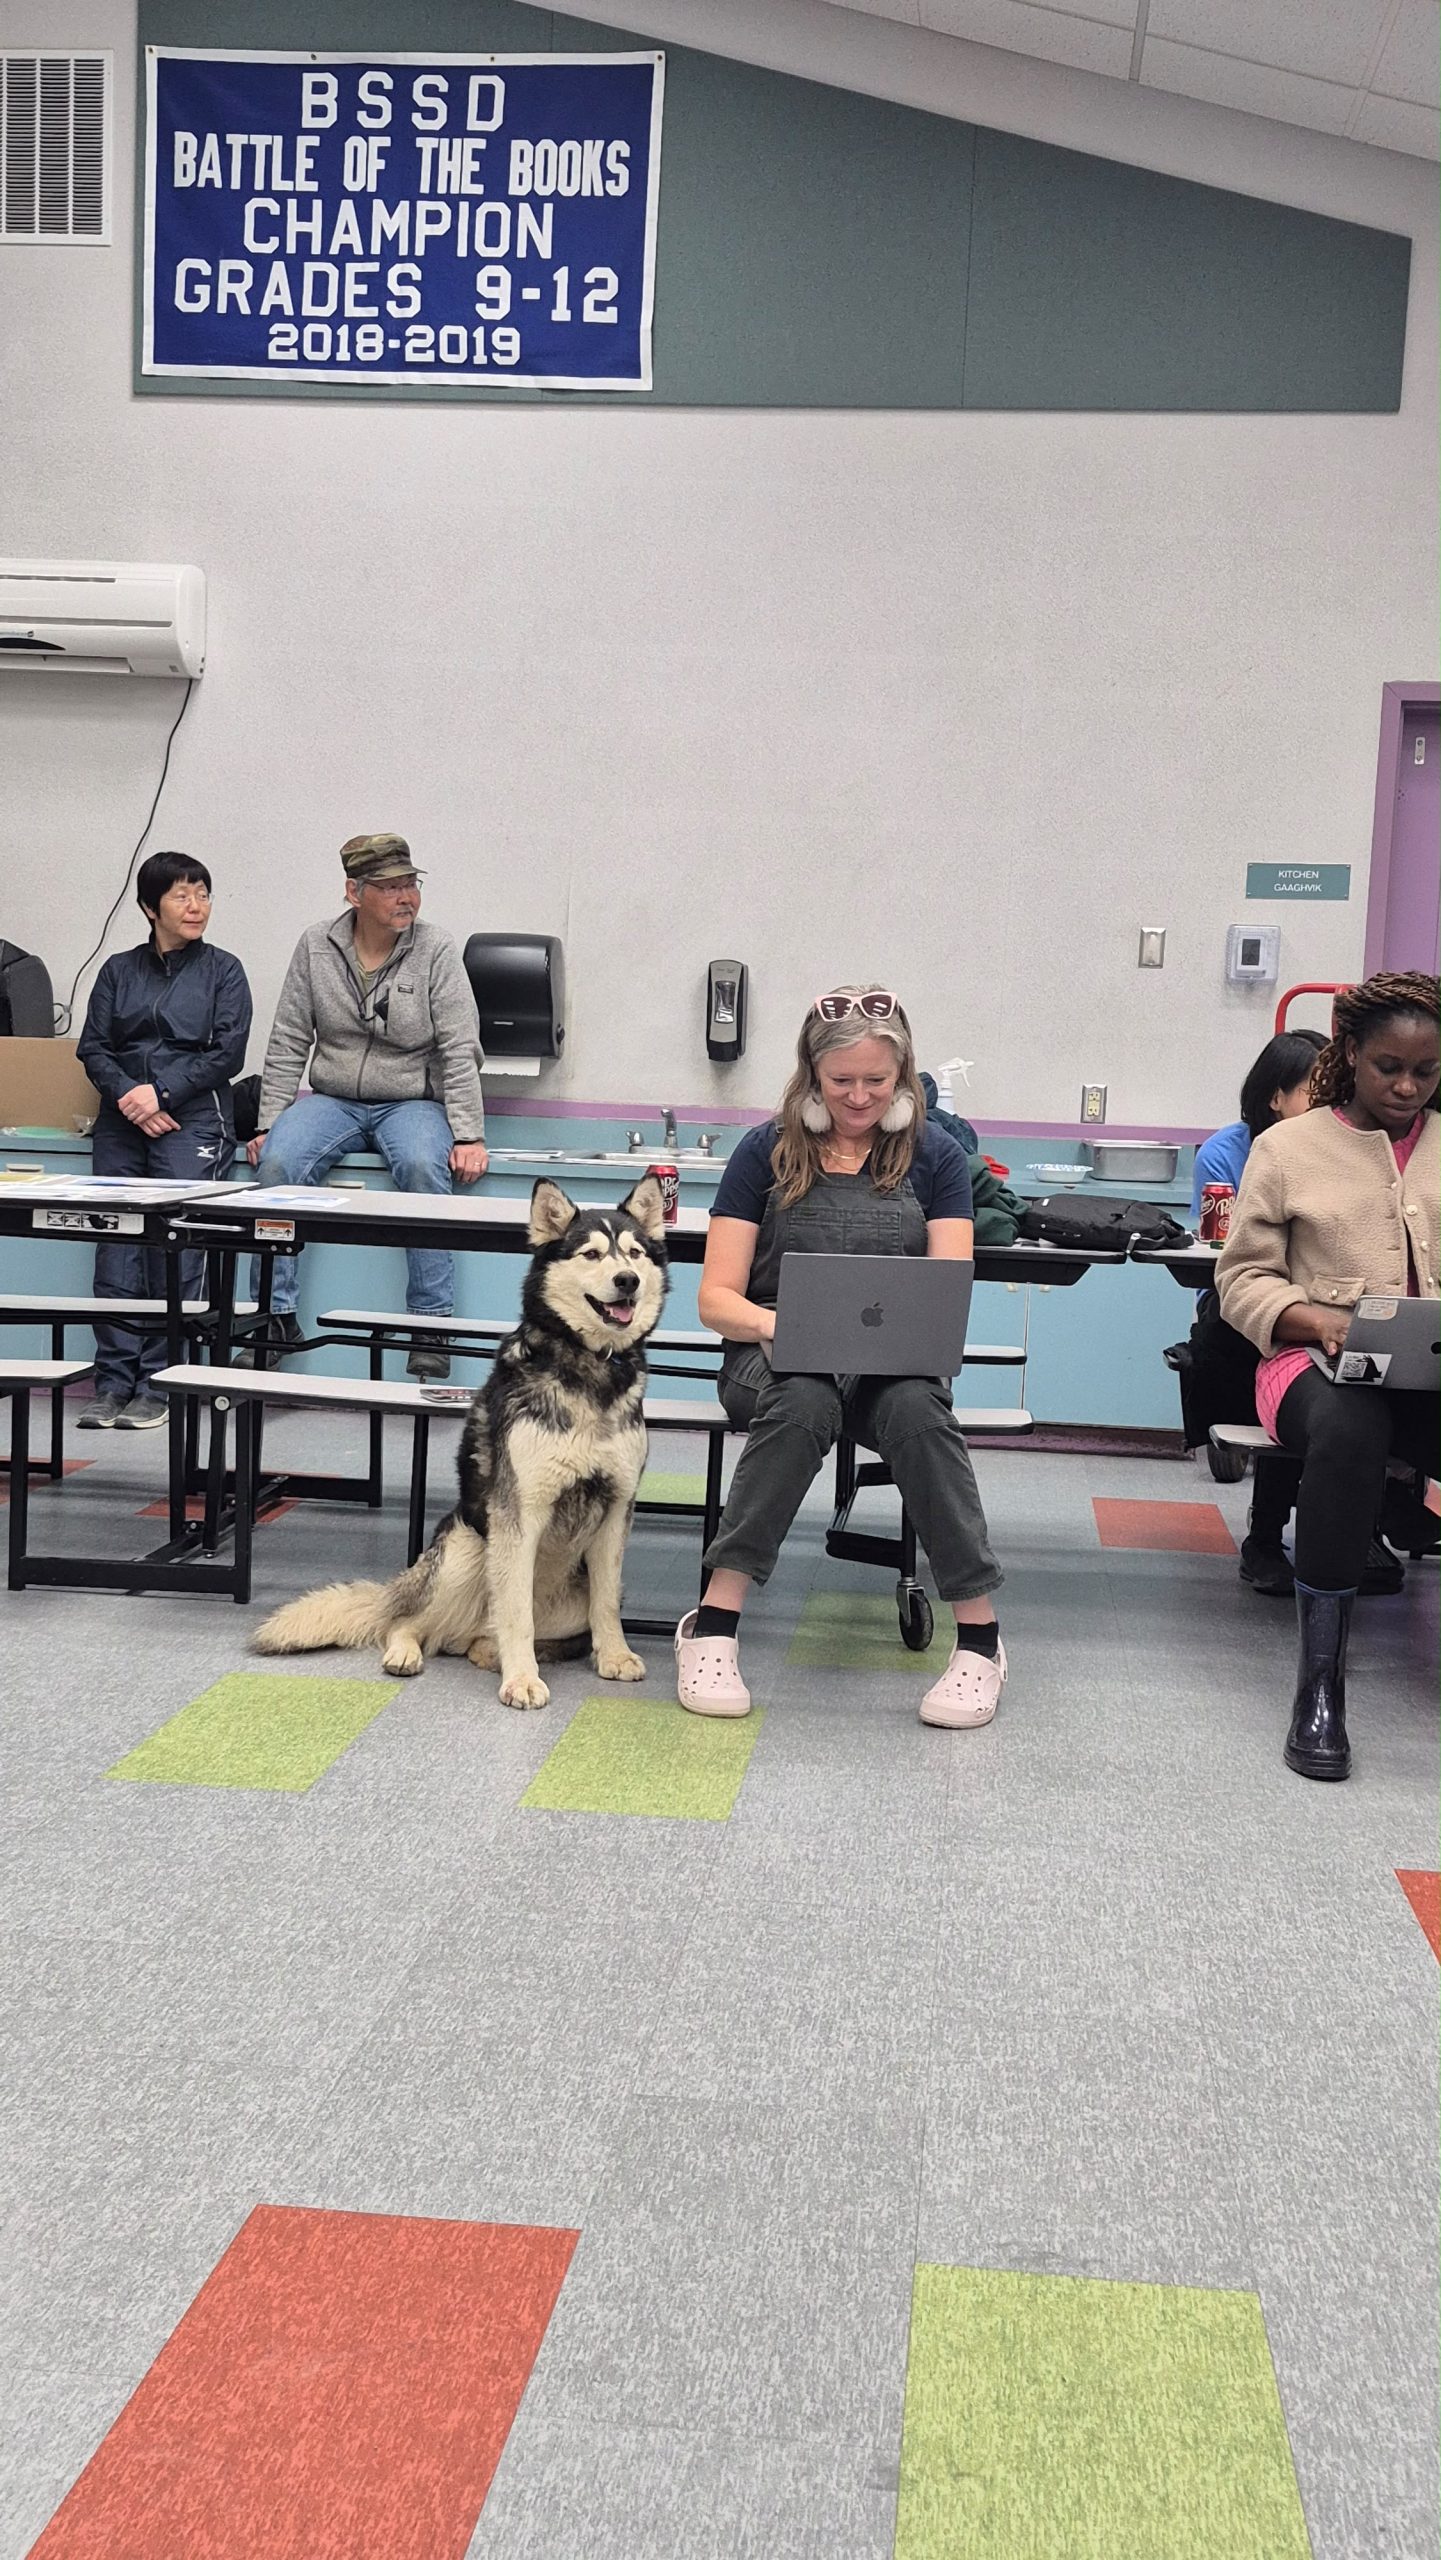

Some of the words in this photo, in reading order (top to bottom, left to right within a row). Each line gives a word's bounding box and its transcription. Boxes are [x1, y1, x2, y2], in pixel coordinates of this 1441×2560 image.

[173, 131, 320, 192] BATTLE
[343, 136, 392, 193] OF
[415, 137, 487, 195] THE
[507, 139, 631, 197] BOOKS
[243, 197, 554, 260] CHAMPION
[174, 258, 422, 319] GRADES
[475, 264, 619, 324] 9-12
[267, 322, 521, 365] 2018-2019
[1273, 883, 1322, 892] GAAGHVIK
[1278, 870, 1319, 879] KITCHEN
